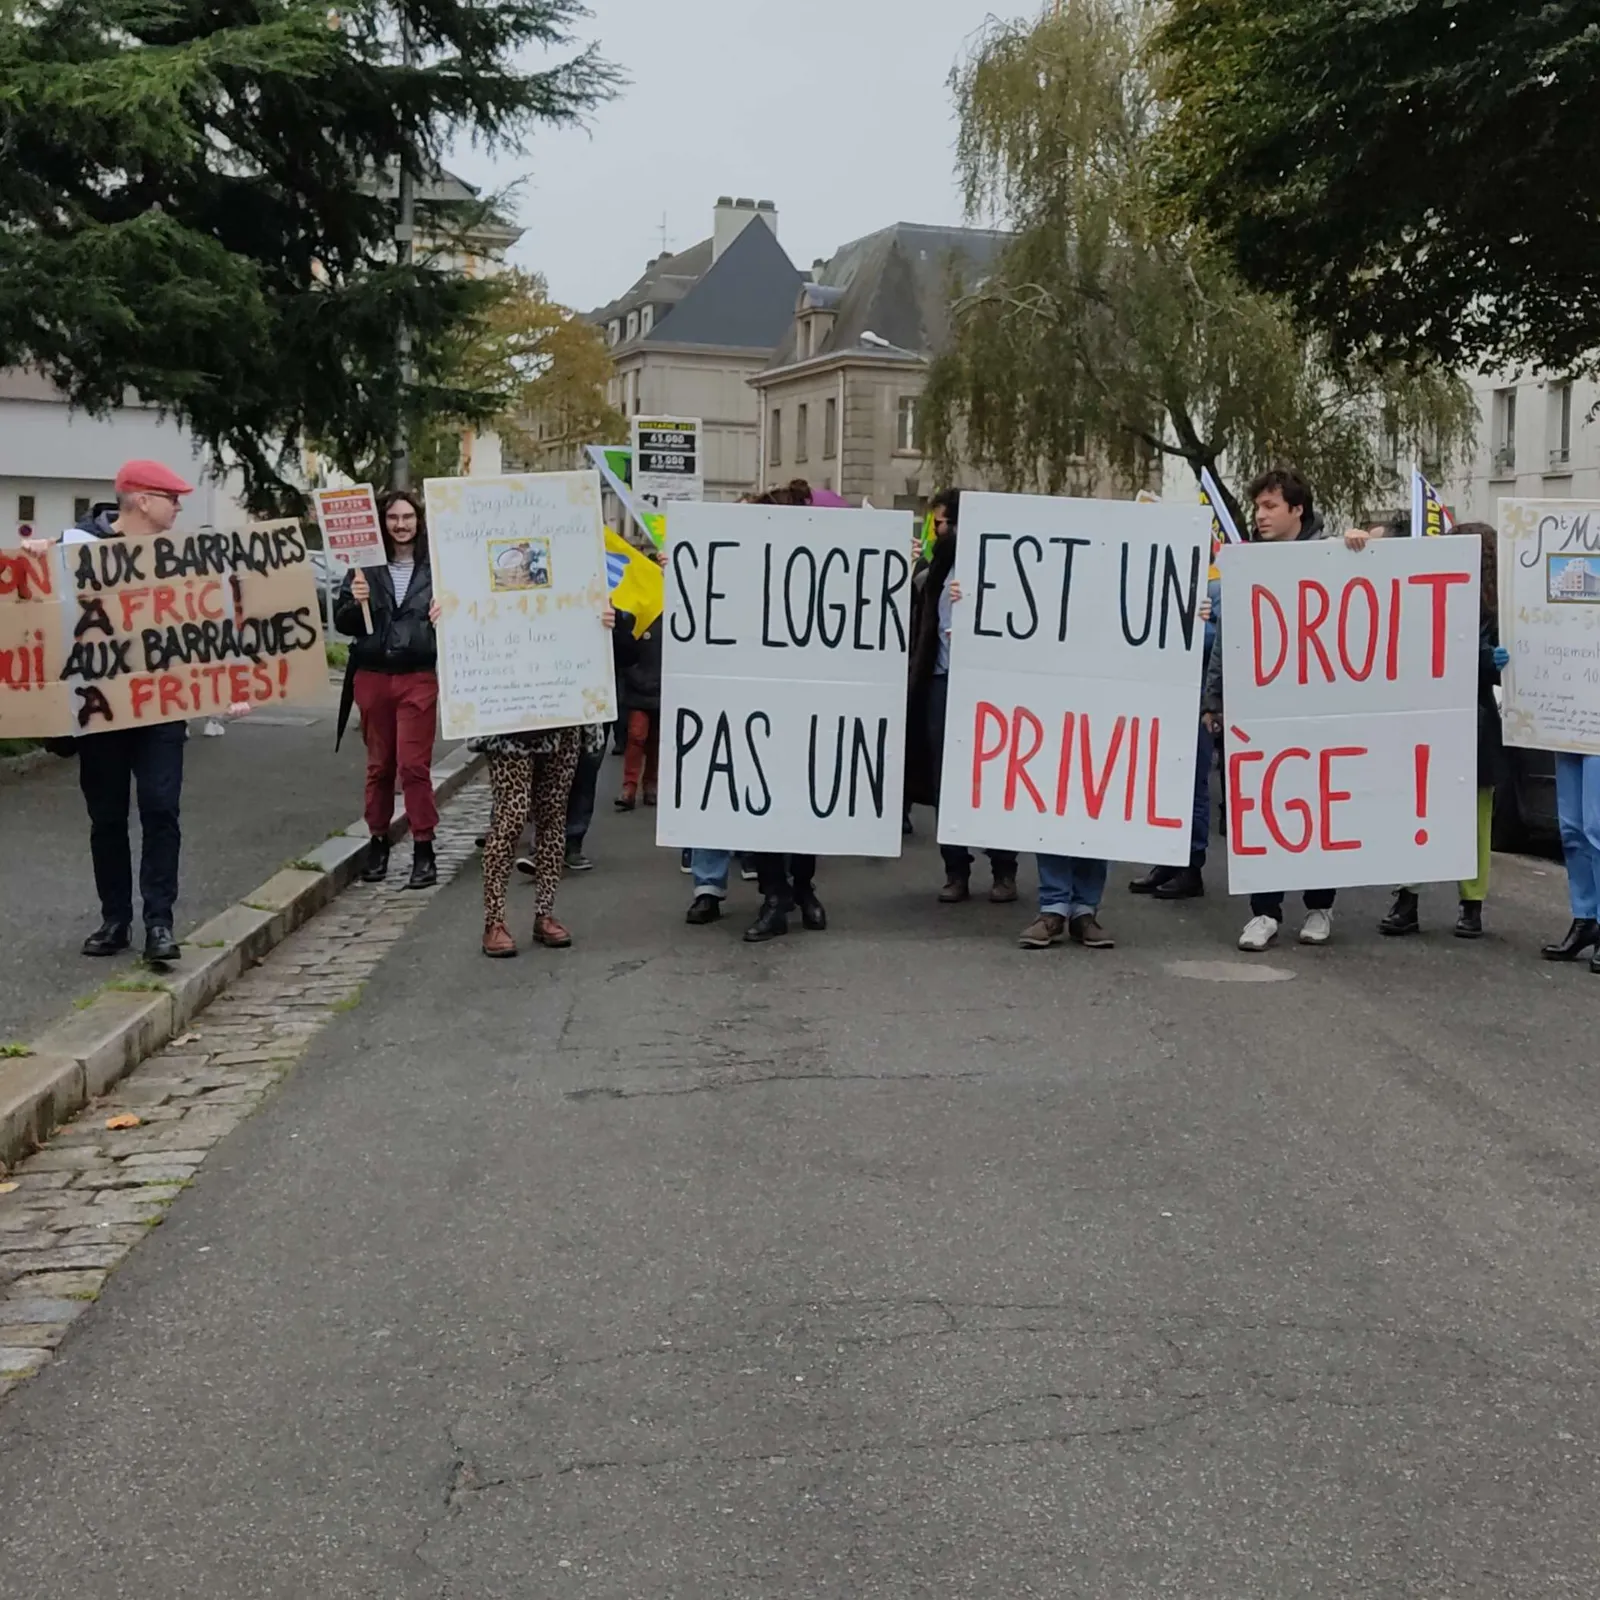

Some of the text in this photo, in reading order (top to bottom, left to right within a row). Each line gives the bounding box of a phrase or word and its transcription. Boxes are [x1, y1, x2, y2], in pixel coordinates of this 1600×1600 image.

[75, 542, 145, 591] AUX
[153, 525, 305, 579] BARRAQUES
[670, 541, 909, 653] SE LOGER
[973, 533, 1200, 651] EST UN
[60, 639, 131, 680] AUX
[142, 606, 316, 672] BARRAQUES
[504, 630, 521, 645] de
[1250, 572, 1471, 687] DROIT
[674, 707, 888, 819] PAS UN
[971, 700, 1184, 830] PRIVIL
[1228, 725, 1431, 856] ÈGE !
